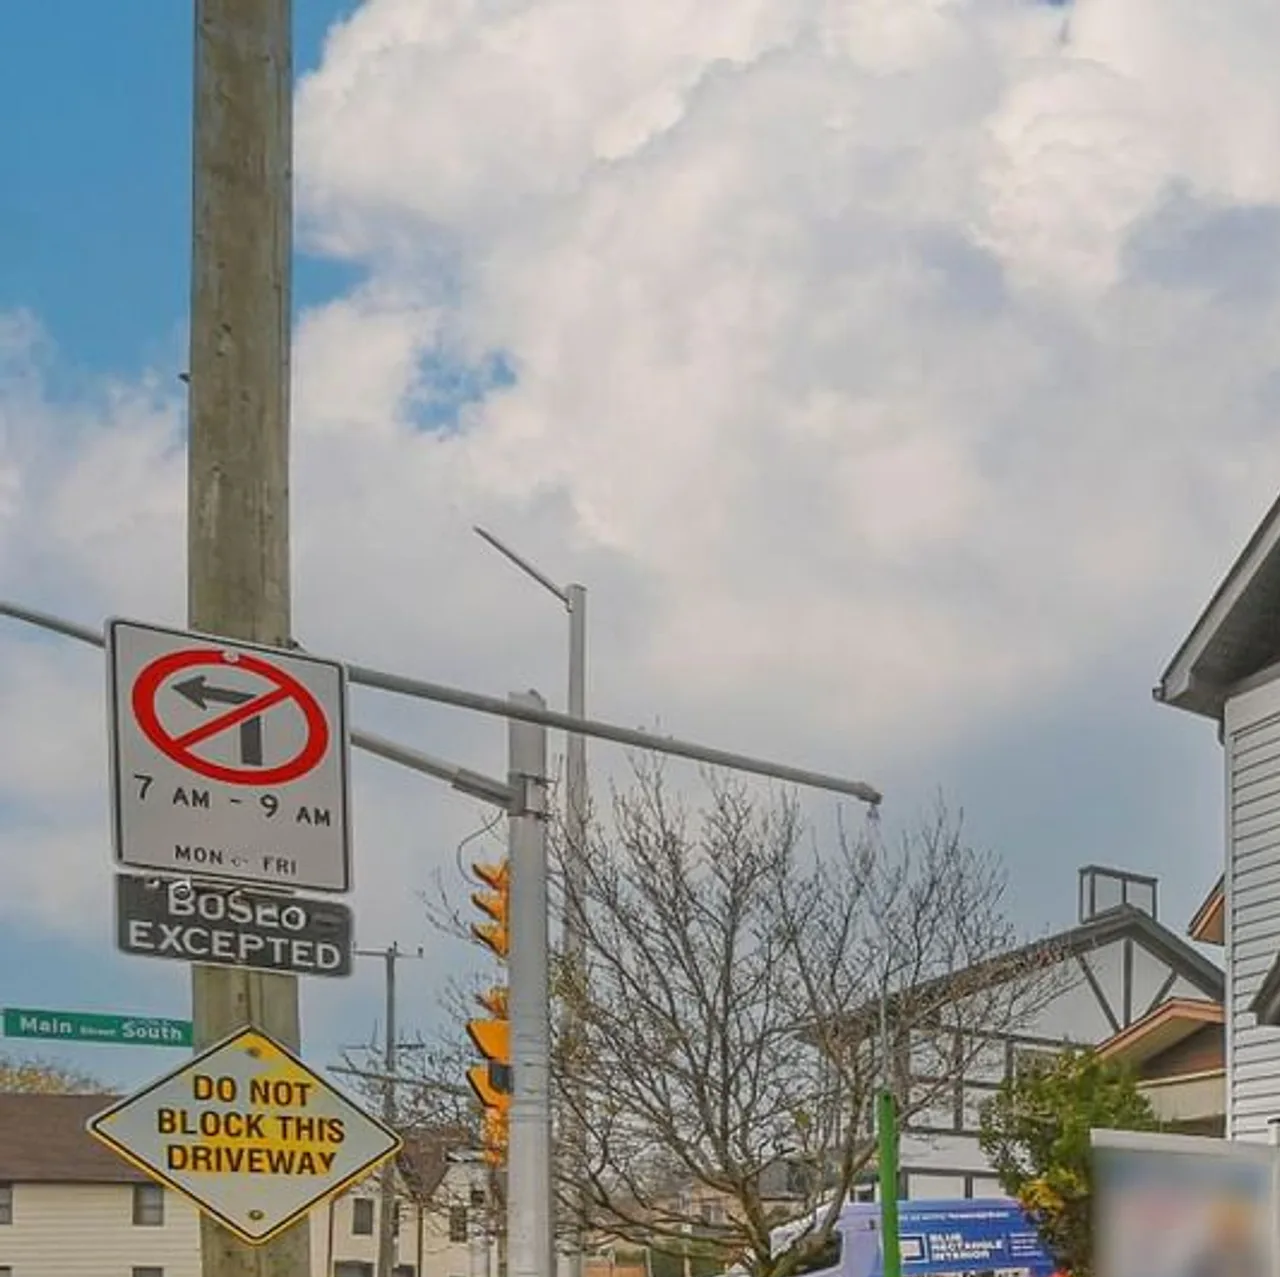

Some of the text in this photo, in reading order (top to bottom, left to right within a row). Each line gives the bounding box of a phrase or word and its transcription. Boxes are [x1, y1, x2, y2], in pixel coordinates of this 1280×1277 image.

[134, 774, 153, 799] 7
[172, 787, 210, 809] AM
[260, 794, 279, 818] 9
[296, 806, 331, 827] AM
[175, 845, 223, 866] MON
[263, 857, 297, 875] FRI
[129, 920, 341, 969] EXCEPTED
[20, 1015, 72, 1034] Main
[121, 1019, 182, 1041] South
[193, 1075, 312, 1107] DO NOT
[158, 1108, 345, 1143] BLOCK THIS
[167, 1144, 337, 1174] DRIVEWAY
